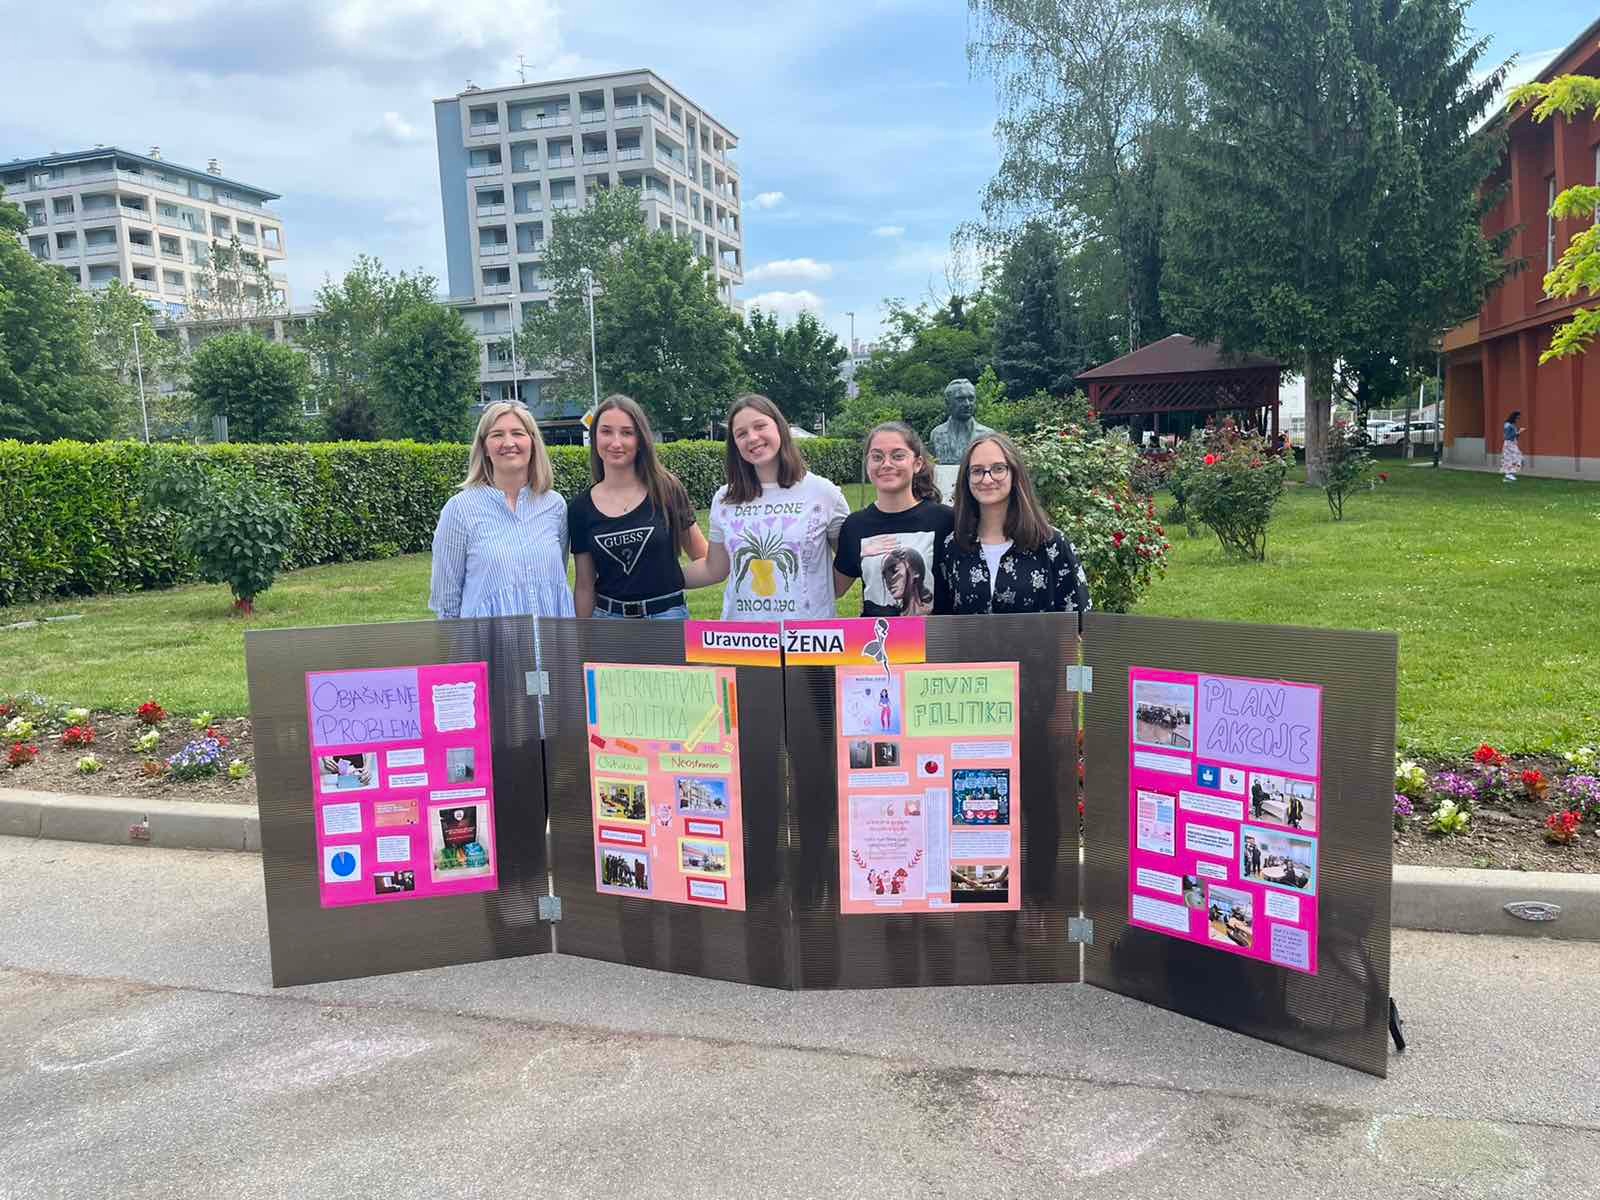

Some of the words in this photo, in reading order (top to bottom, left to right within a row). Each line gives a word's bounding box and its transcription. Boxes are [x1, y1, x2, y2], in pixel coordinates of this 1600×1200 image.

[735, 505, 761, 517] DAY
[764, 502, 803, 515] DONE
[604, 531, 643, 548] GUESS
[737, 599, 771, 612] DONE
[600, 669, 716, 704] ALTERNATIVNA
[920, 676, 988, 697] JAVNA
[1203, 679, 1286, 717] PLAN
[317, 714, 423, 744] PROBLEMA
[609, 702, 688, 738] POLITIKA
[913, 700, 1013, 729] POLITIKA
[1206, 717, 1312, 764] AKCIJE
